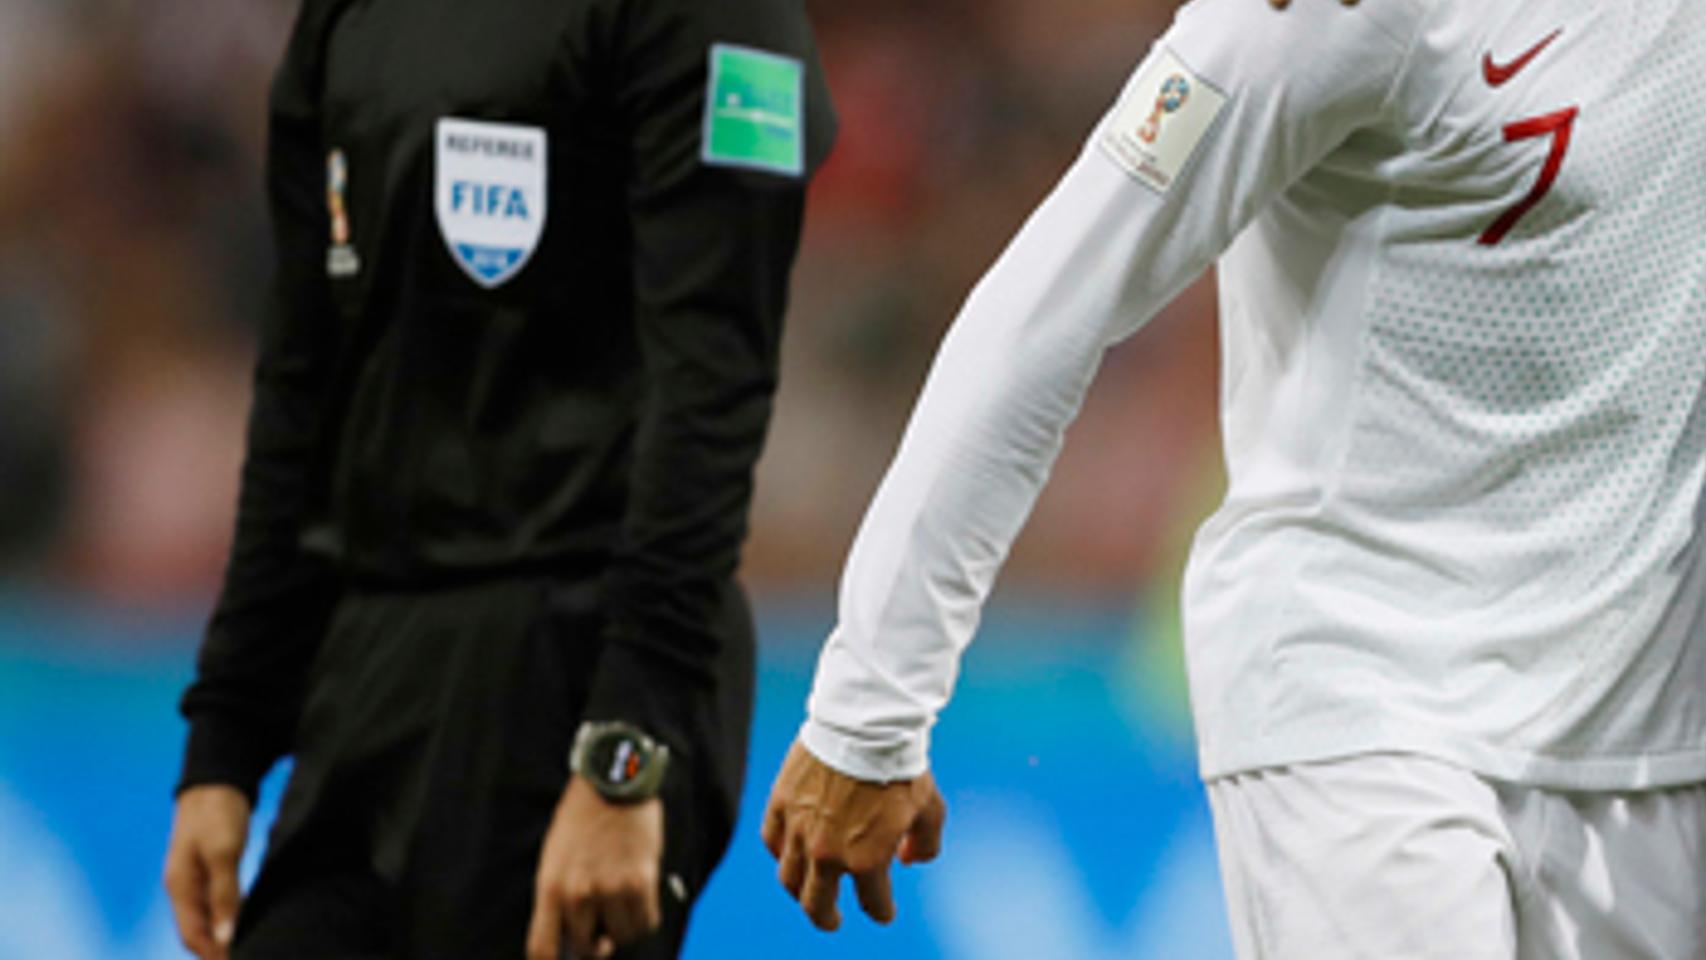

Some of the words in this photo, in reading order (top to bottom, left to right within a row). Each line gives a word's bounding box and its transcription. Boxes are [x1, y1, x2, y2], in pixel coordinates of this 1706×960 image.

[446, 133, 534, 160] REFEREE
[1477, 105, 1579, 244] 7
[451, 180, 530, 220] FIFA
